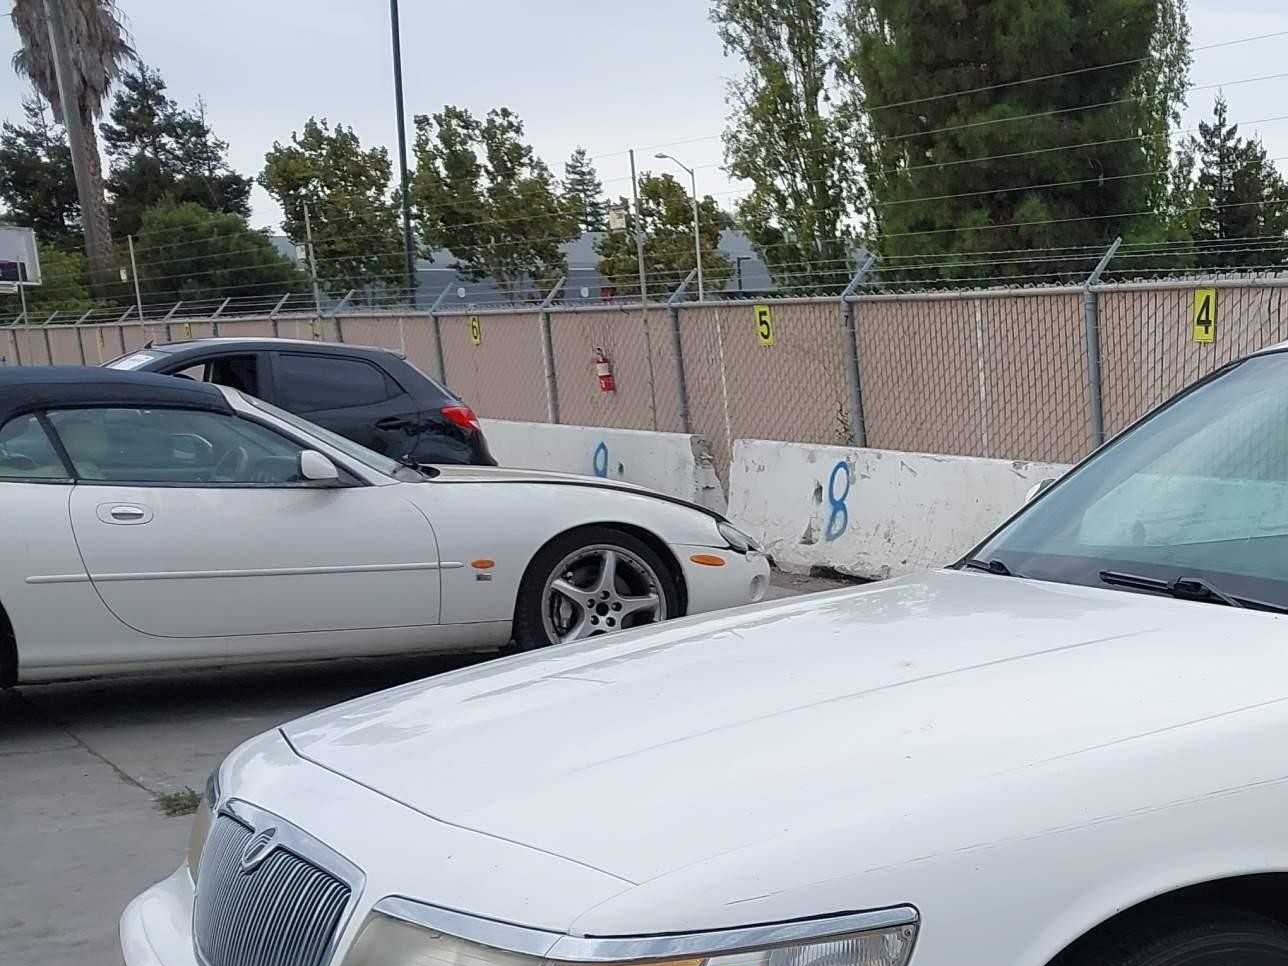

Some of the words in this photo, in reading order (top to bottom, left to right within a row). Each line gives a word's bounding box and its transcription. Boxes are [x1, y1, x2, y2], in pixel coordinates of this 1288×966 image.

[471, 317, 479, 340] 6
[759, 310, 770, 340] 5
[1196, 294, 1212, 335] 4
[825, 461, 850, 542] 8
